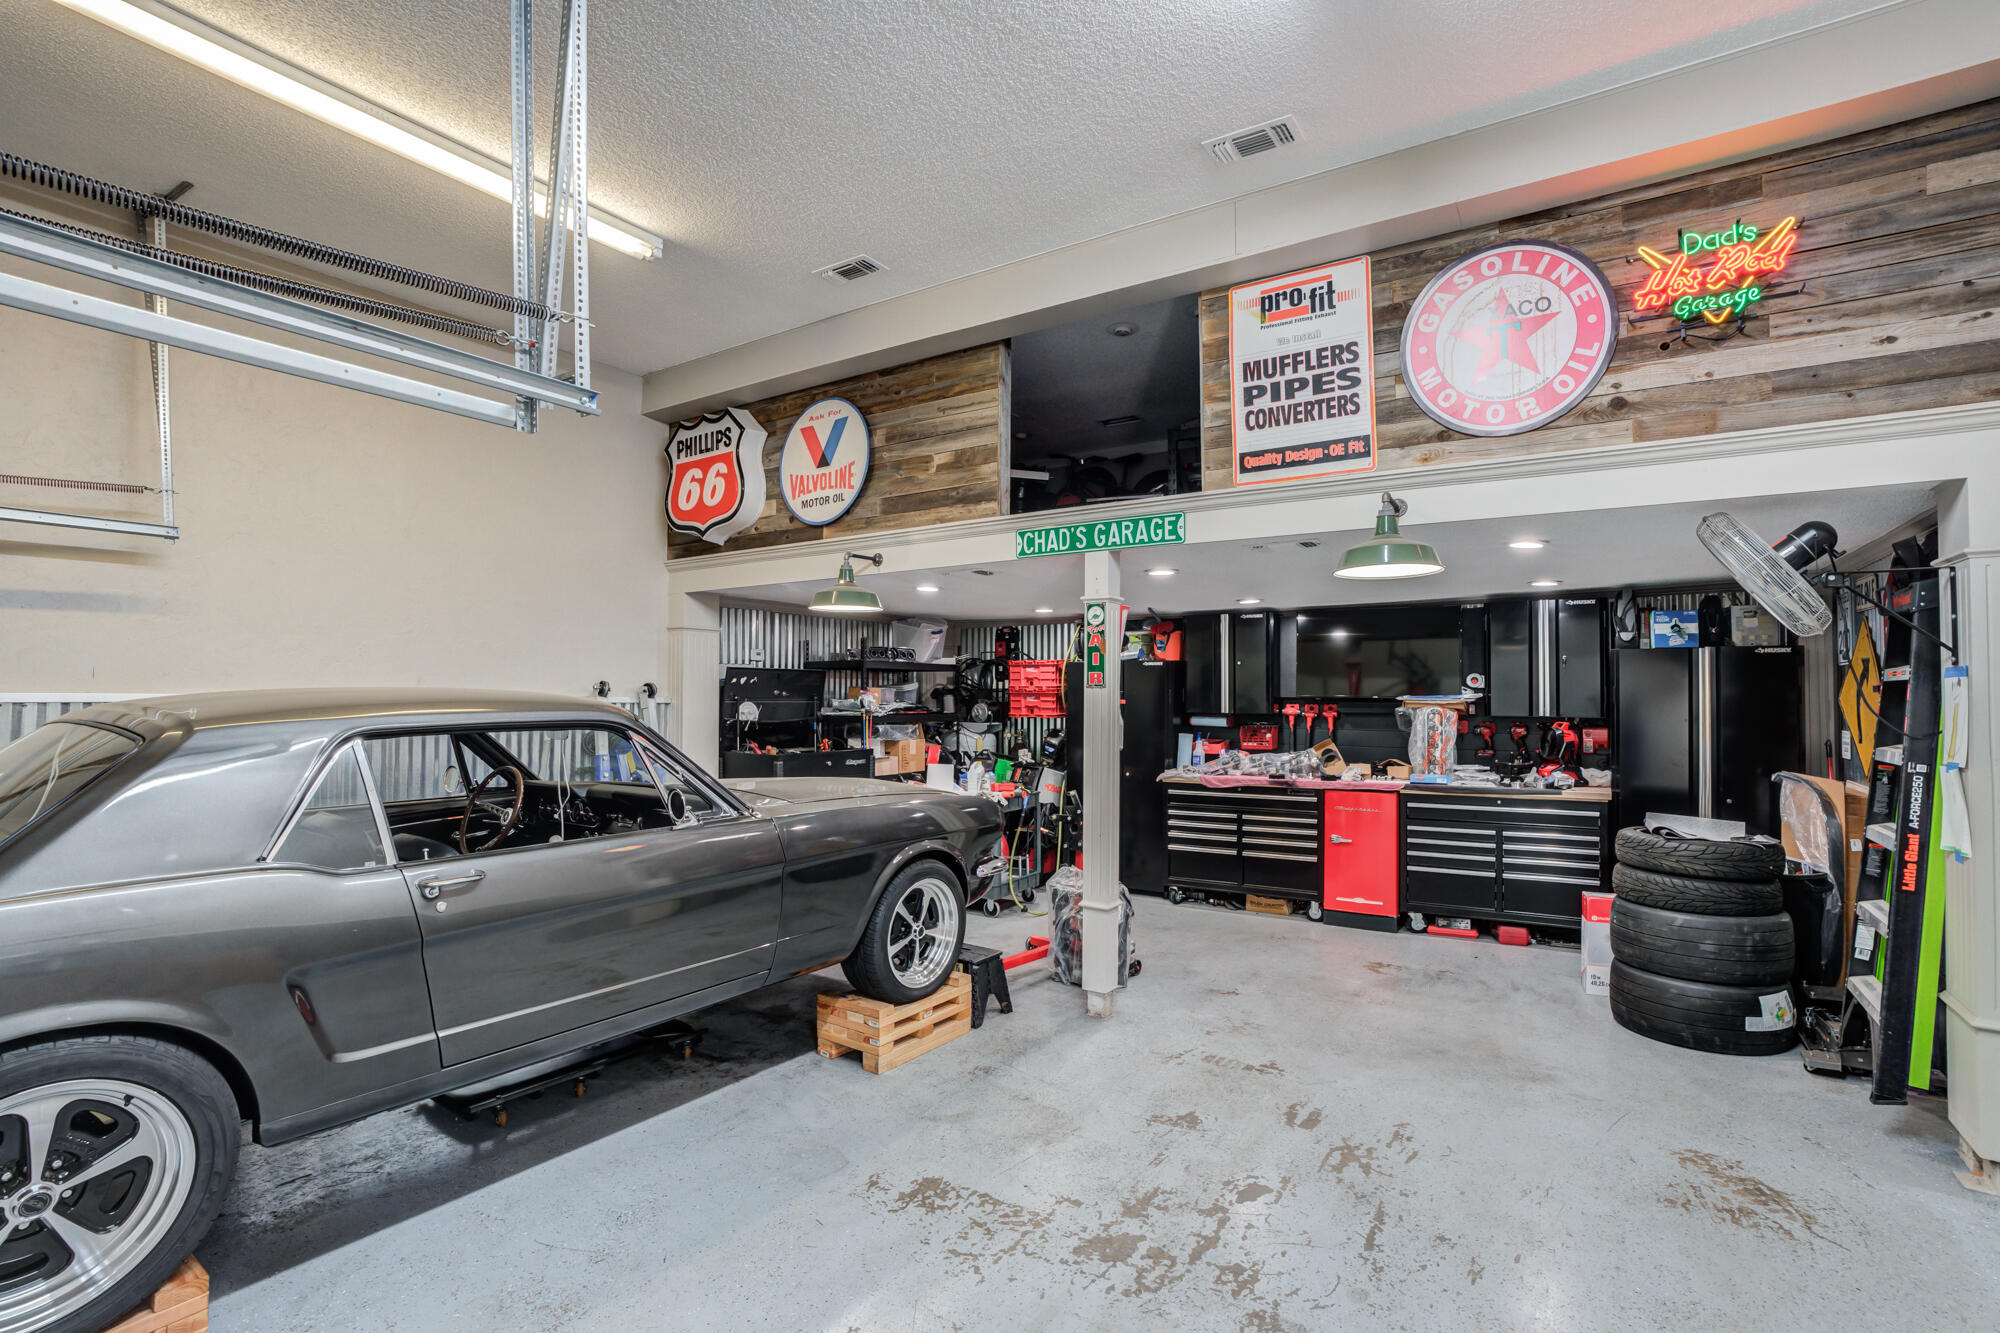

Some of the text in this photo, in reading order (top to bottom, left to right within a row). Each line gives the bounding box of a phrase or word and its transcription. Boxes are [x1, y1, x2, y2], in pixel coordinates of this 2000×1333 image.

[1682, 223, 1759, 256] Dad's
[1417, 249, 1597, 334] GASOLINE
[1634, 233, 1798, 310] Hot Rod
[1260, 310, 1337, 331] Professional Fitting Exhaust
[1672, 285, 1762, 320] Garage
[1242, 341, 1360, 383] MUFFLERS
[1243, 366, 1362, 407] PIPES
[1416, 340, 1601, 425] MOTOR OIL
[828, 408, 842, 417] For
[1244, 392, 1360, 432] CONVERTERS
[676, 426, 732, 460] PHILLIPS
[1243, 440, 1365, 469] Quality Design OE Fit
[677, 462, 729, 511] 66
[790, 461, 856, 501] VALVOLINE
[801, 492, 845, 509] MOTOR OIL
[1023, 516, 1177, 554] CHAD'S GARAGE
[1088, 633, 1103, 685] AIR
[1908, 775, 1924, 830] A-FORCE250
[1901, 832, 1921, 892] Little Giant
